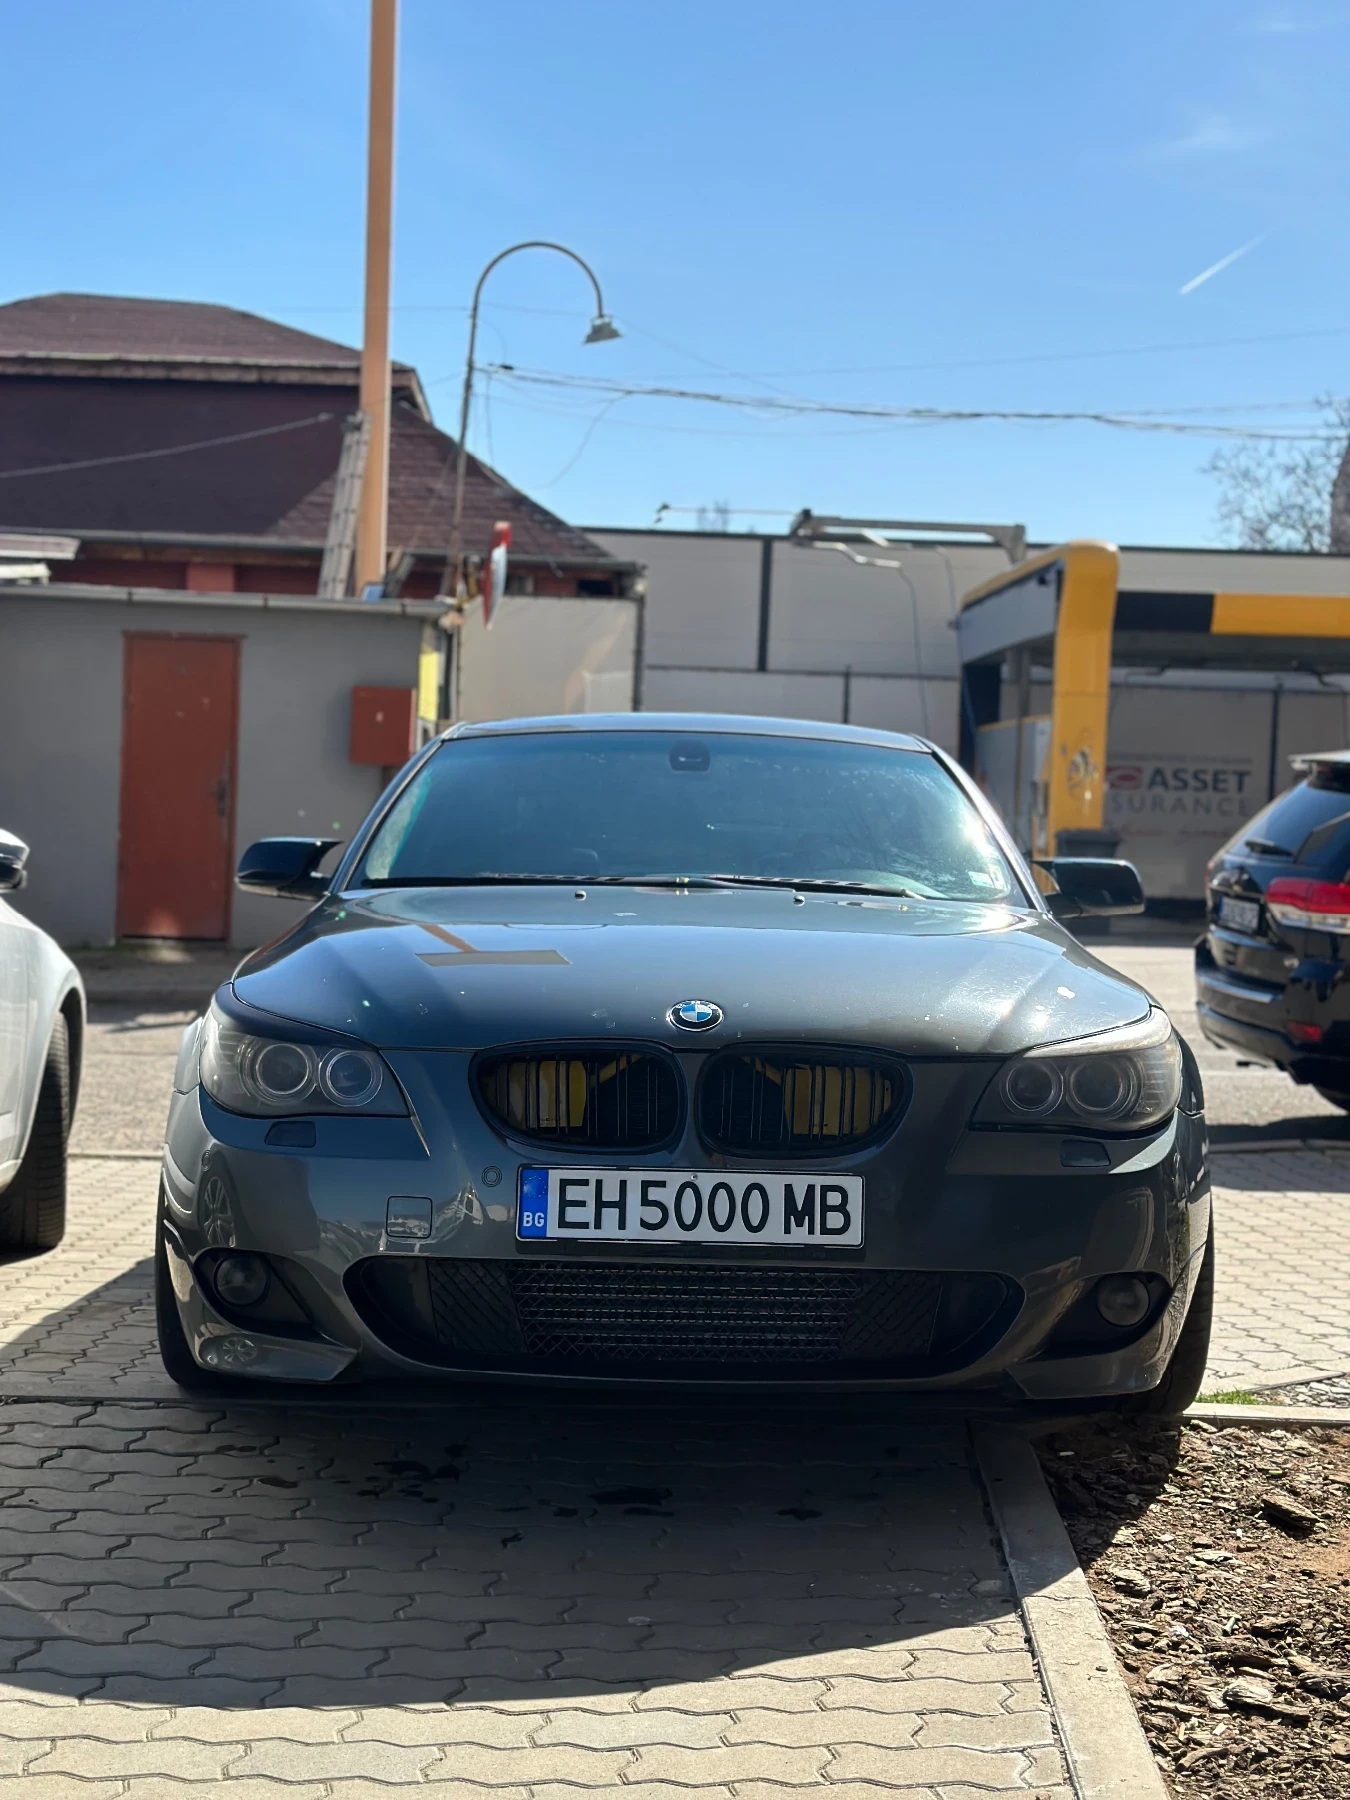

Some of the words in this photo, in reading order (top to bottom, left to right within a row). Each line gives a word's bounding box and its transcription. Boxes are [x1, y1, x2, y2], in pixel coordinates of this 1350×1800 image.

[1147, 766, 1252, 794] ASSET
[1110, 792, 1252, 818] SURANCE
[522, 1211, 545, 1228] BG
[557, 1178, 627, 1231] EH
[639, 1180, 771, 1234] 5000
[783, 1183, 852, 1236] MB
